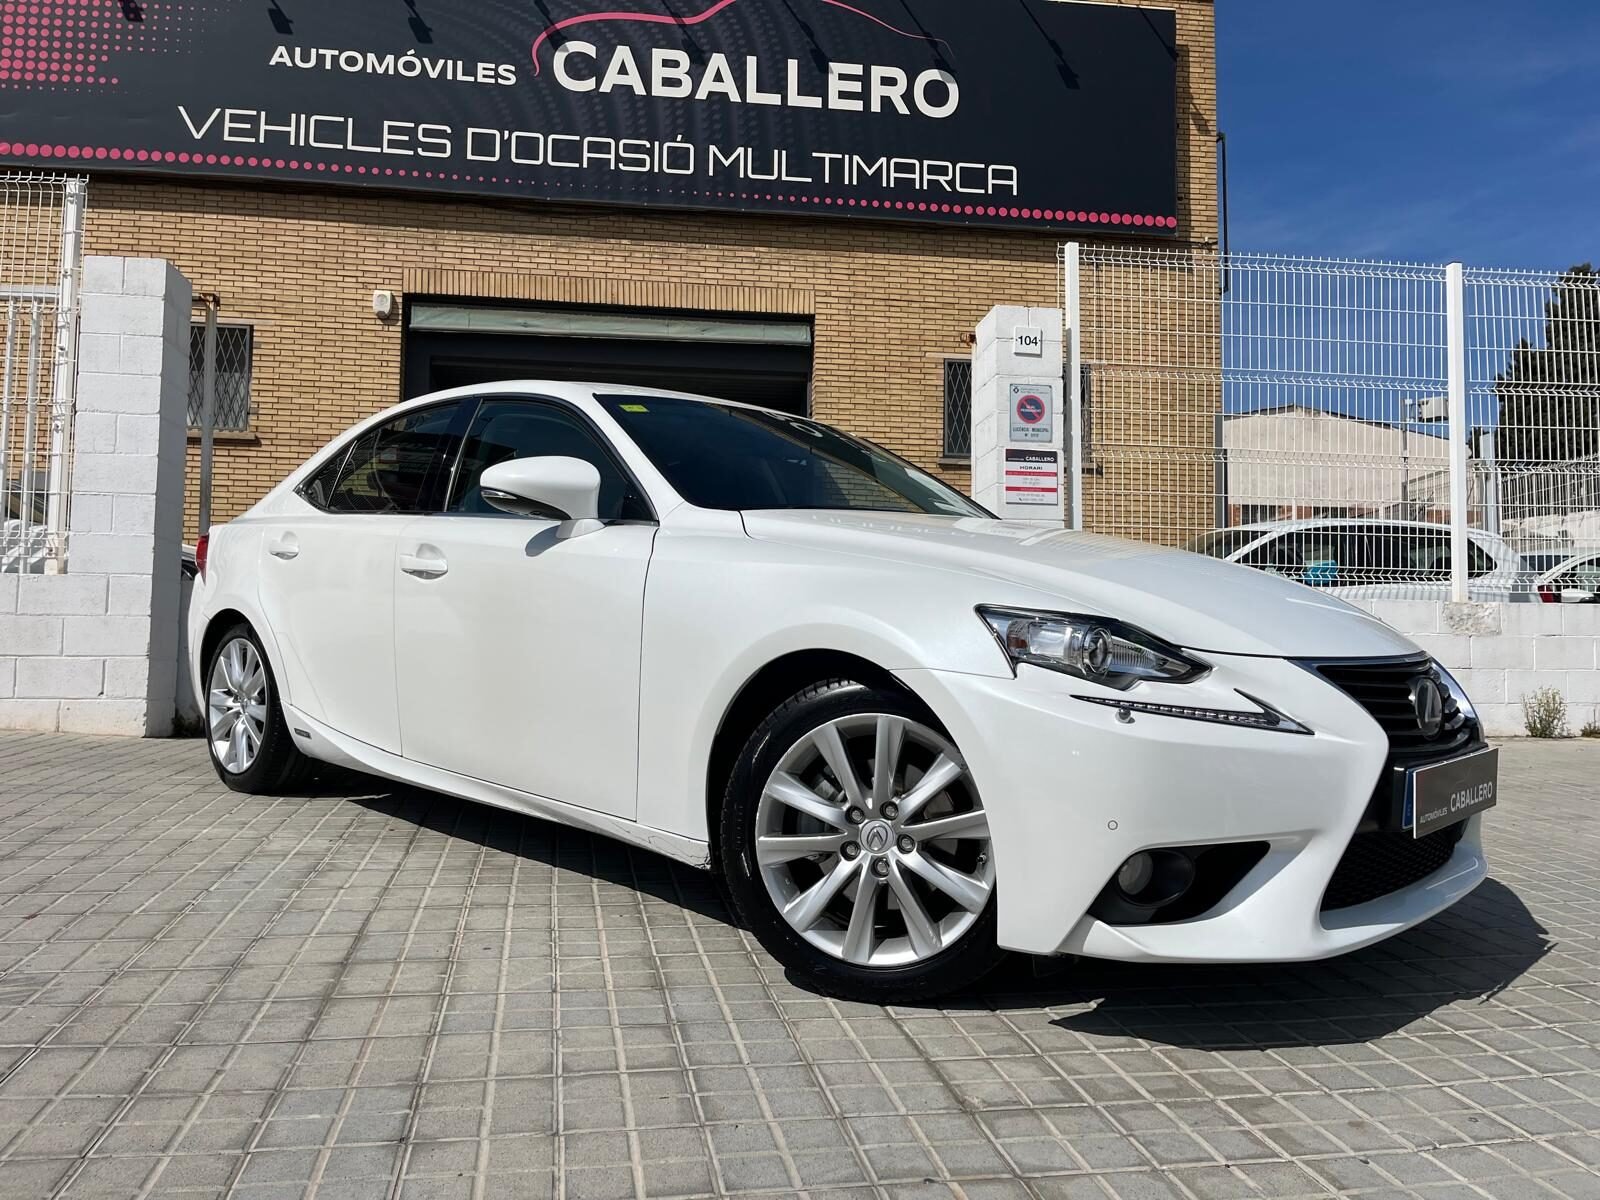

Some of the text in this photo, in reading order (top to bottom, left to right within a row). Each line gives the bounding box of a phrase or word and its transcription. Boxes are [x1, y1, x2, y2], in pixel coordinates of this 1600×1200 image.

[268, 39, 960, 119] AUTOMÓVILES CABALLERO
[177, 105, 1018, 196] VEHICLES D'OCASIÓ MULTIMARCA
[1017, 335, 1039, 346] 104
[1450, 781, 1493, 813] CABALLERO
